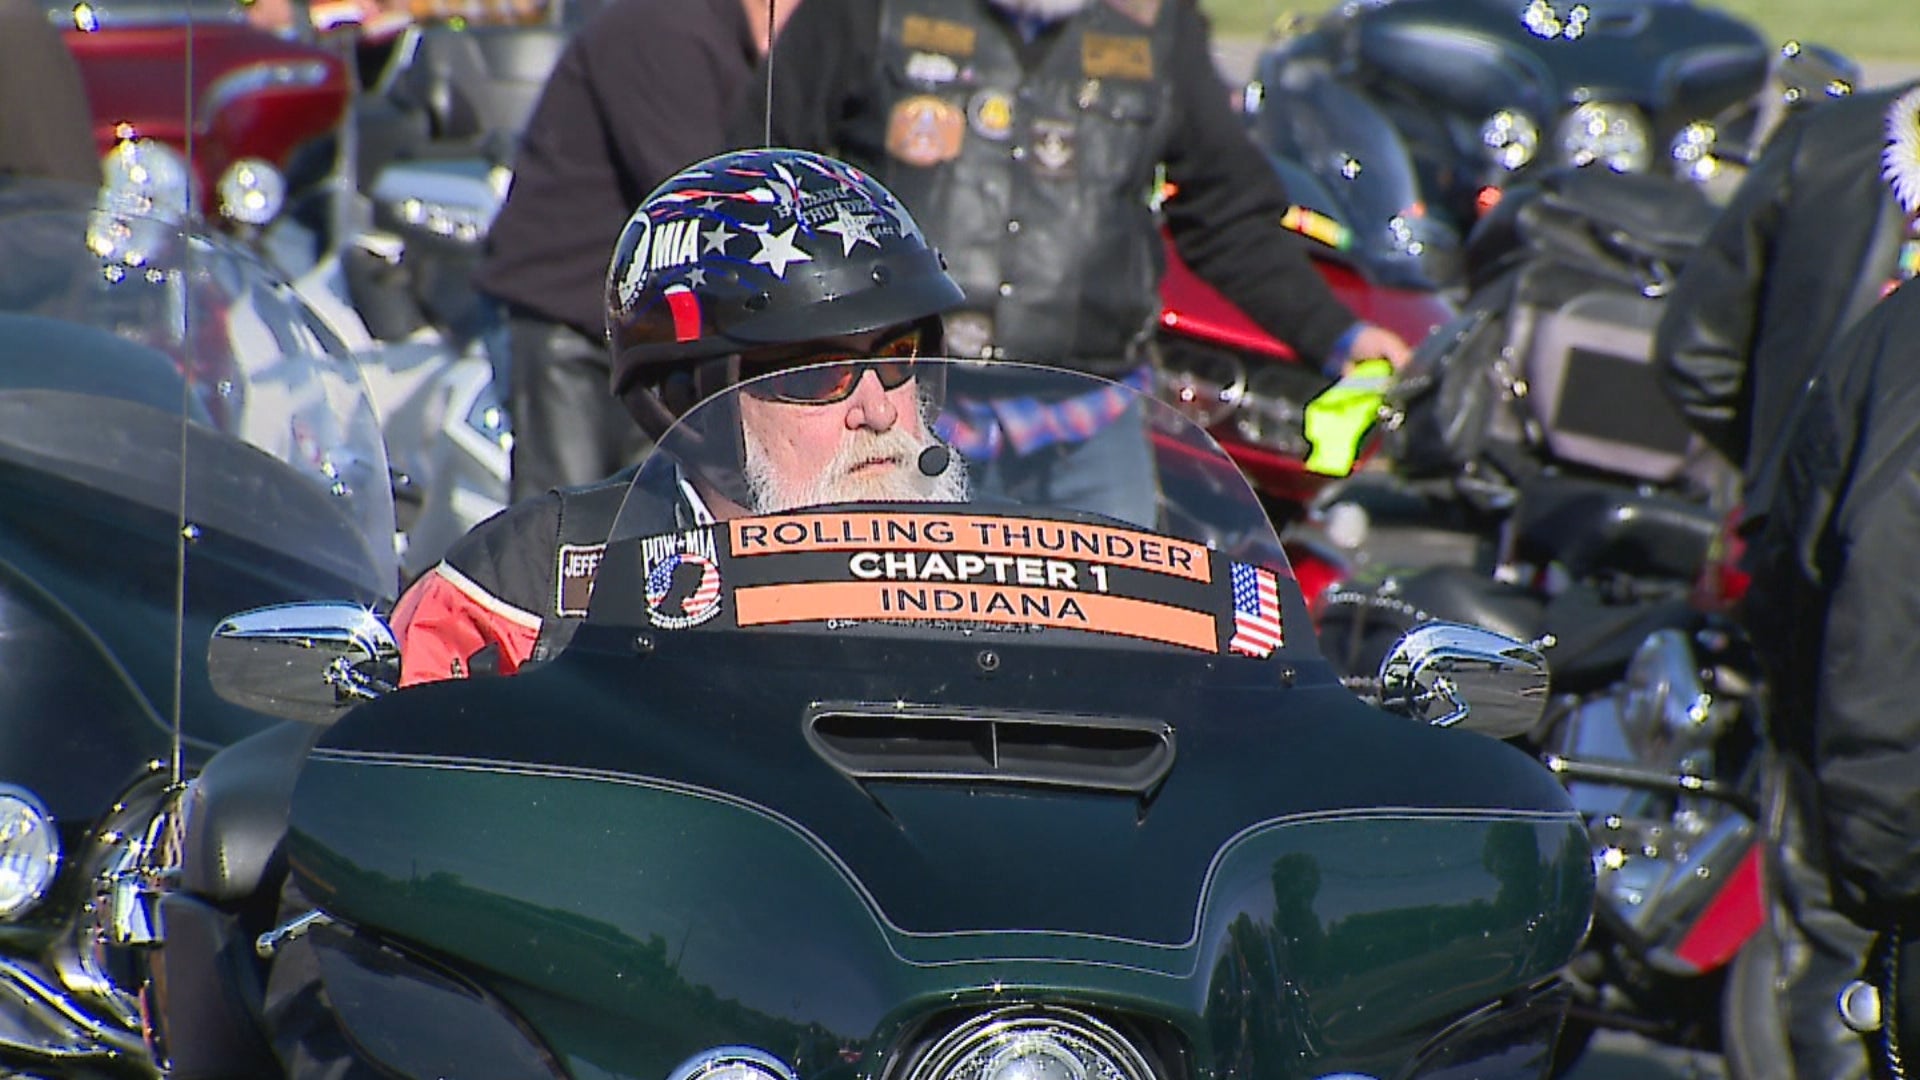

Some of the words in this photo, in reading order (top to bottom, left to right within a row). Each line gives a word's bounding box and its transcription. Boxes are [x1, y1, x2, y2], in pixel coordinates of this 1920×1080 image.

[650, 218, 701, 271] MIA
[685, 526, 719, 567] MIA
[741, 519, 955, 551] ROLLING
[971, 522, 1193, 571] THUNDER
[849, 550, 1079, 591] CHAPTER
[1090, 565, 1109, 593] 1
[881, 587, 1088, 624] INDIANA
